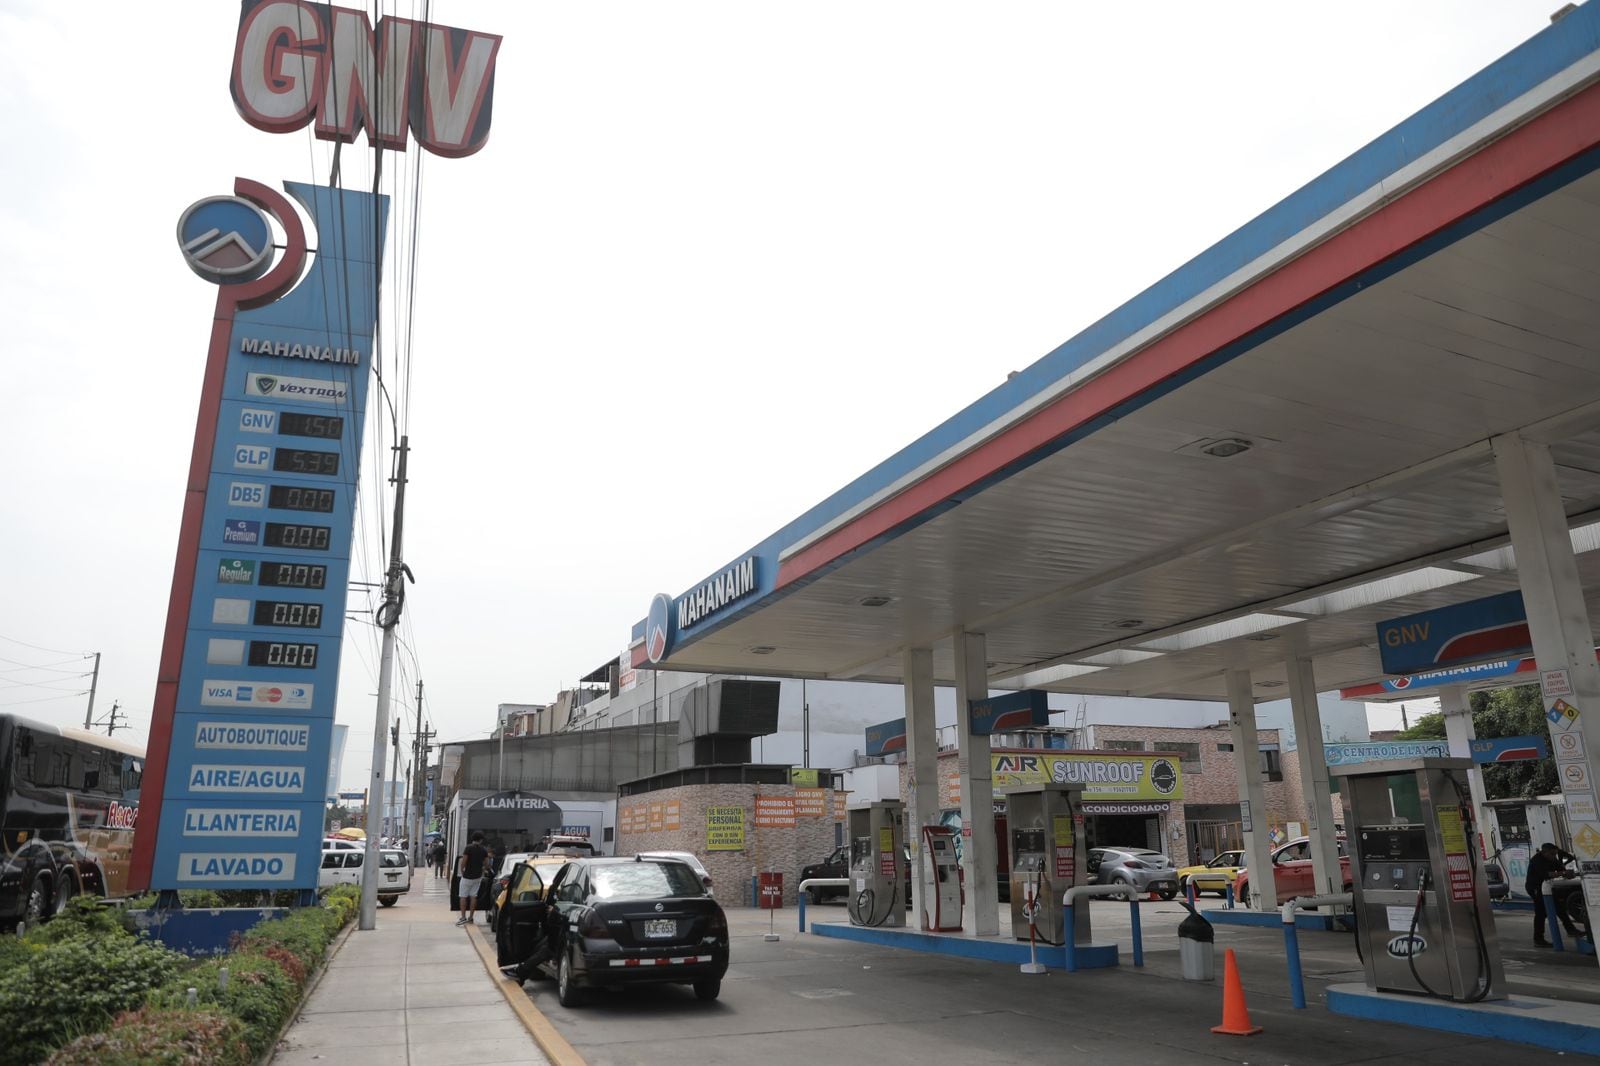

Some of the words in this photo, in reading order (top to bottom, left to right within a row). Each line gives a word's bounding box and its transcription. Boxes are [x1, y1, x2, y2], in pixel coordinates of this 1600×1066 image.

[231, 0, 503, 156] GNV
[241, 337, 360, 365] MAHANAIM
[241, 412, 273, 428] GNV
[236, 449, 268, 464] GLP
[231, 486, 261, 502] DB5
[224, 527, 257, 542] Premium
[283, 526, 328, 547] 0.00
[219, 565, 252, 581] Regular
[278, 565, 324, 586] 0.00
[678, 556, 754, 629] MAHANAIM
[273, 604, 320, 626] 0.00
[1385, 621, 1430, 647] GNV
[267, 643, 315, 666] 0.00
[208, 688, 233, 698] VISA
[1568, 709, 1574, 718] 0
[197, 727, 307, 746] AUTOBOUTIQUE
[1343, 744, 1387, 757] CENTRO
[1391, 744, 1405, 755] DE
[1473, 742, 1493, 753] GLP
[995, 756, 1039, 772] AJR
[1053, 760, 1144, 784] SUNROOF
[191, 770, 302, 788] AIRE/AGUA
[484, 798, 550, 808] LLANTERIA
[185, 813, 297, 832] LLANTERIA
[709, 815, 742, 824] PERSONAL
[564, 826, 588, 836] AGUA
[190, 858, 283, 875] LAVADO
